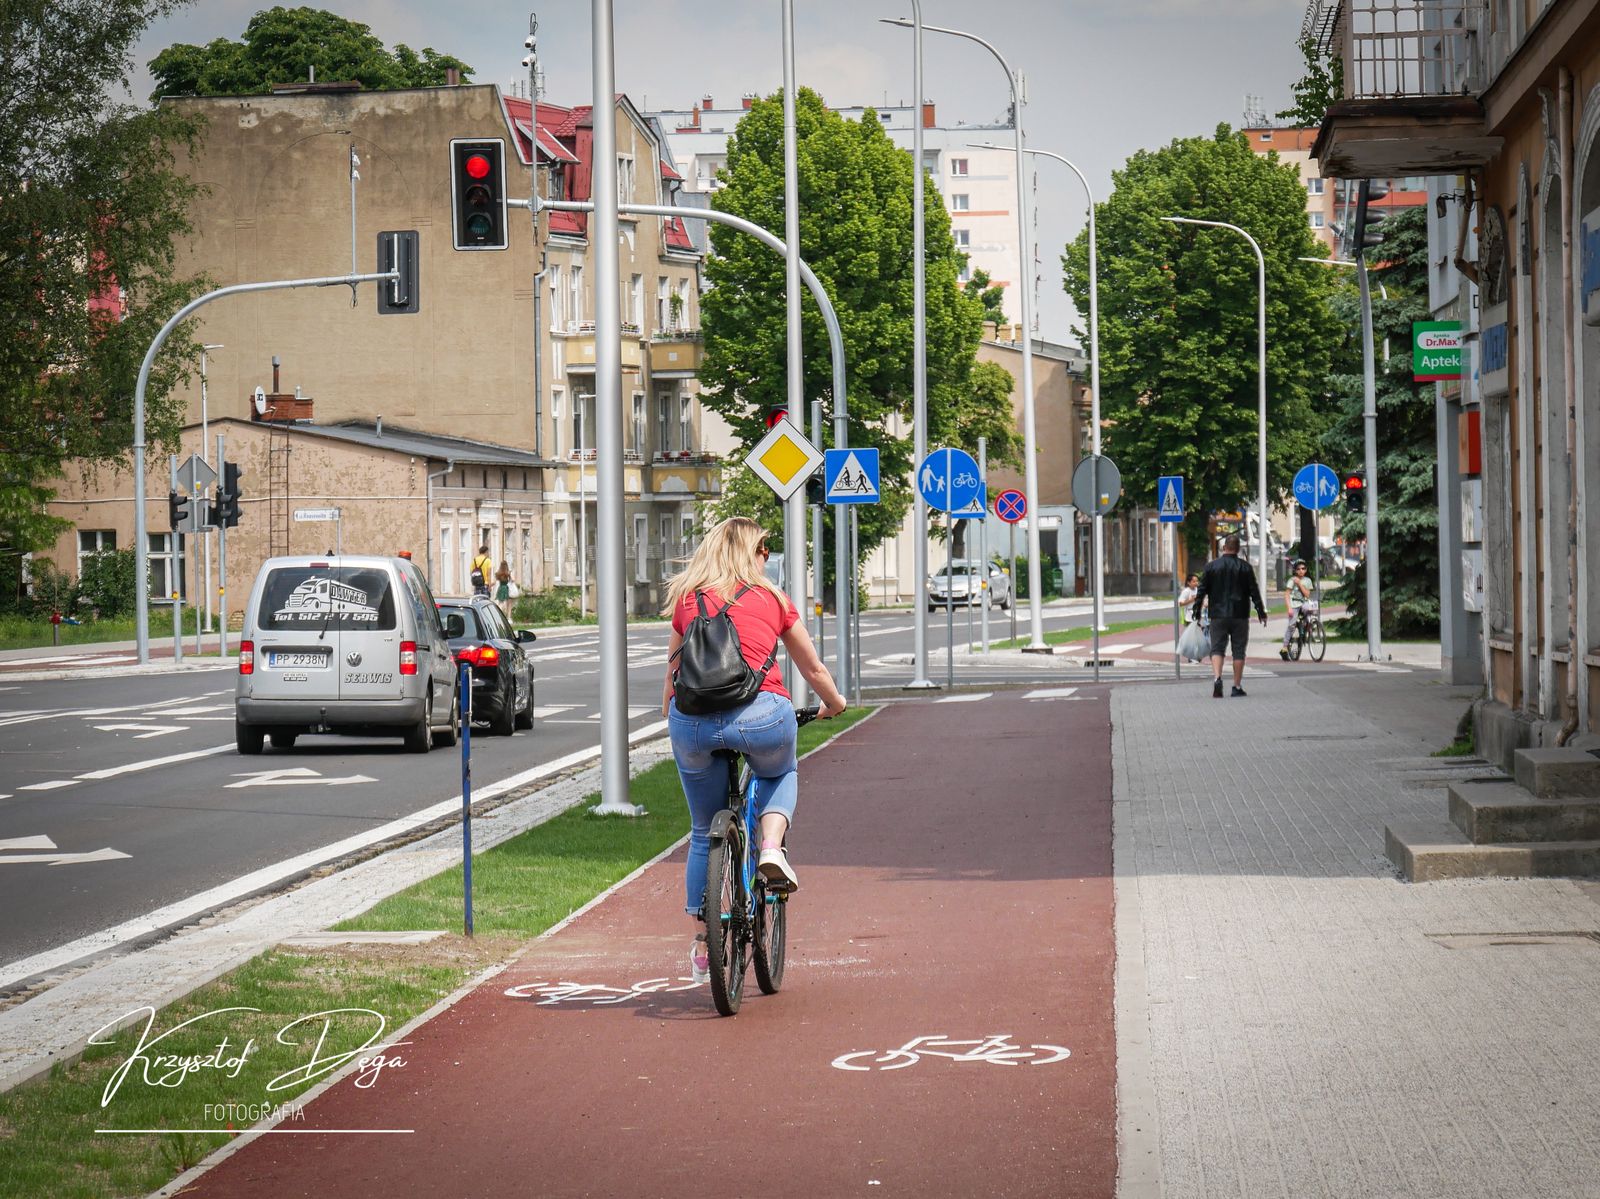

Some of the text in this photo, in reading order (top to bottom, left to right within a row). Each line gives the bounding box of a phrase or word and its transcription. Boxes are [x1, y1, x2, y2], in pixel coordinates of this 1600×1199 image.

[1426, 338, 1457, 347] Dr.Max
[1421, 354, 1462, 370] Aptek
[276, 654, 325, 665] PP 2938N
[343, 672, 393, 684] SERWIS
